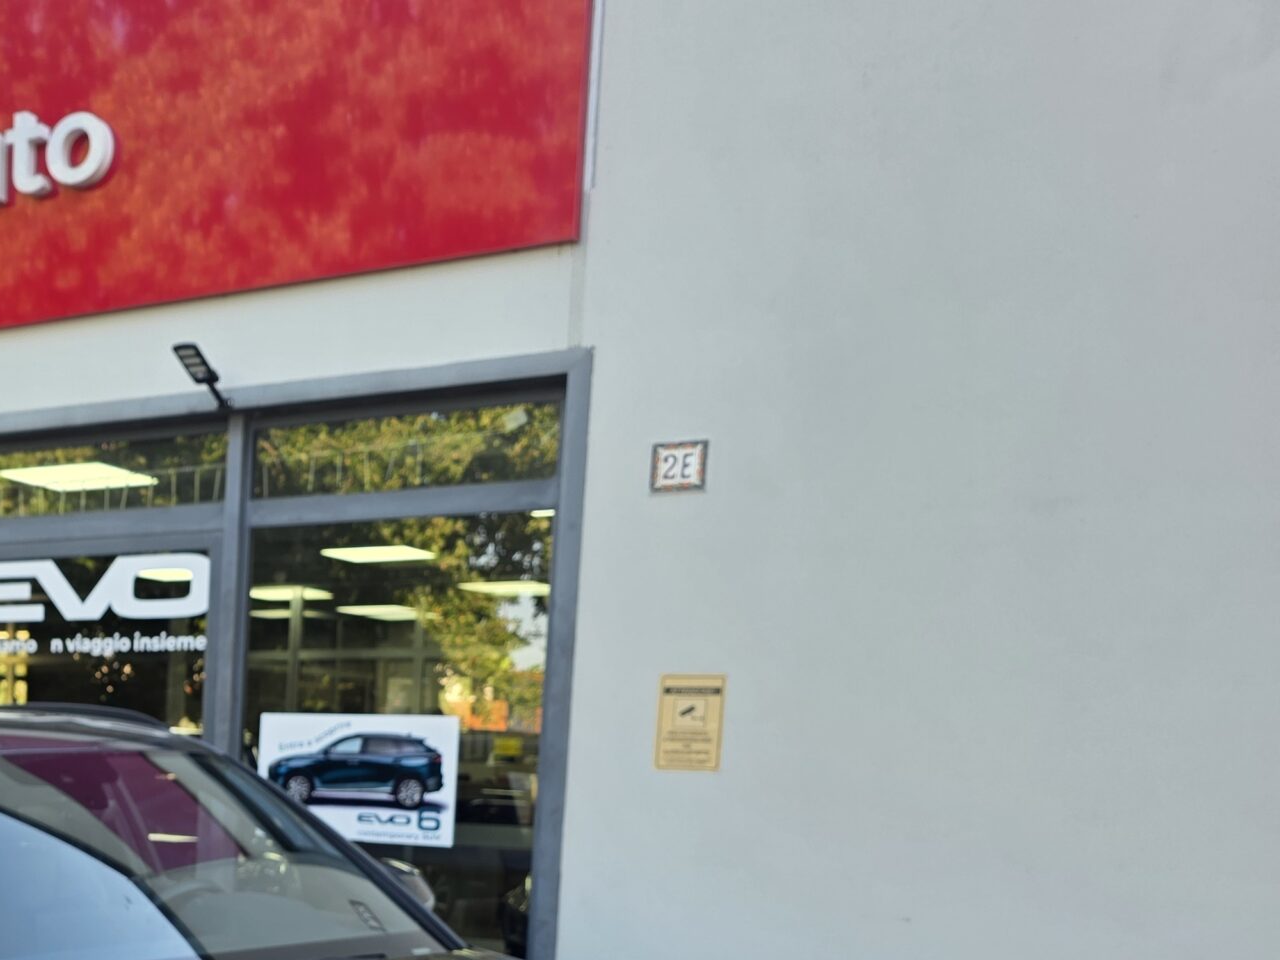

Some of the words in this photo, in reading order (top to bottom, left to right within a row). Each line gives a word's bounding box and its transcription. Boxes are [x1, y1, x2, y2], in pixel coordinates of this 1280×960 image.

[662, 451, 694, 480] 2E
[66, 632, 131, 657] viaggio
[133, 631, 208, 653] insieme
[357, 812, 412, 826] EVO
[417, 807, 441, 831] 6
